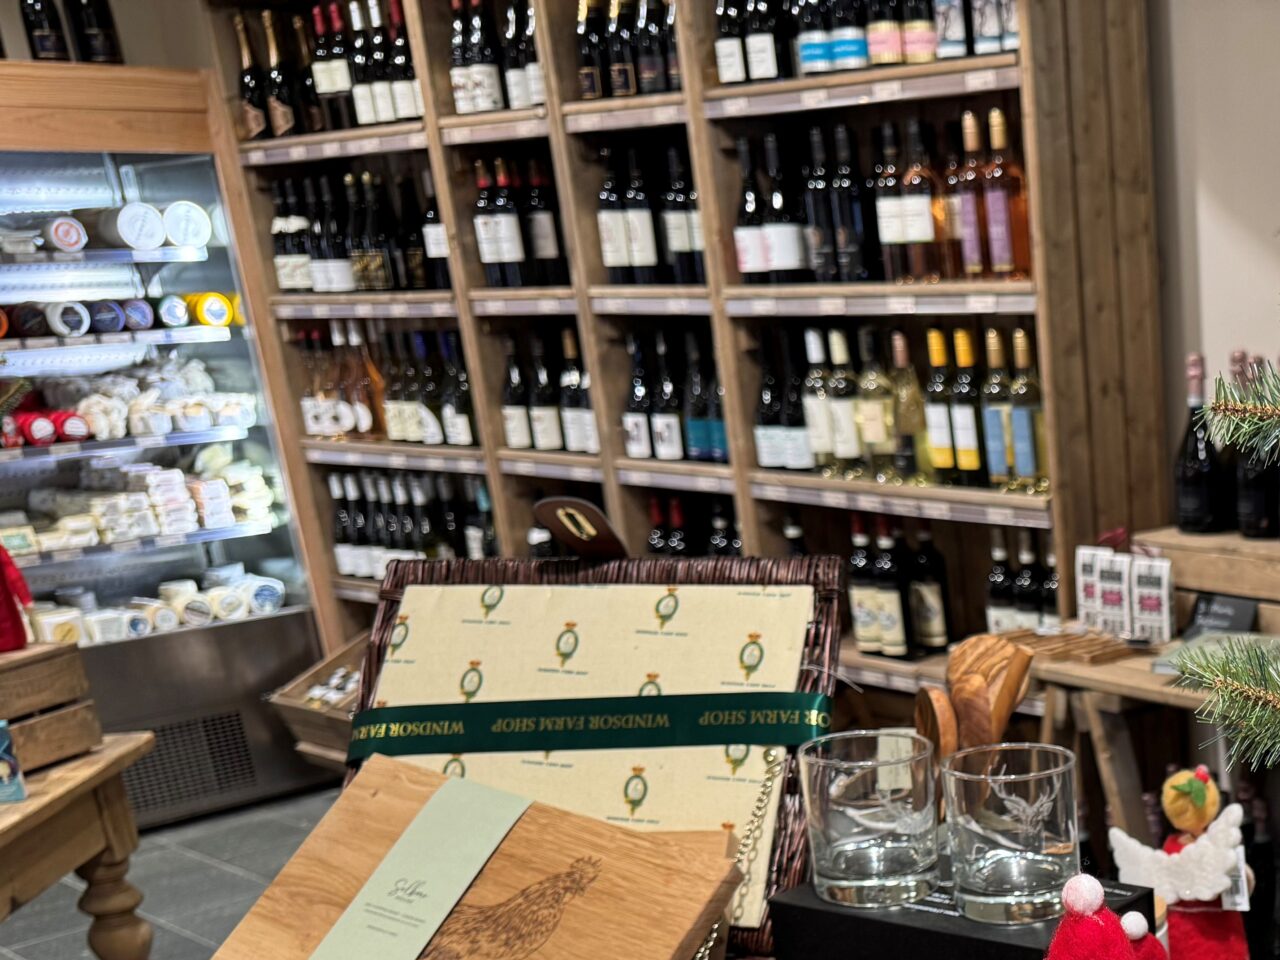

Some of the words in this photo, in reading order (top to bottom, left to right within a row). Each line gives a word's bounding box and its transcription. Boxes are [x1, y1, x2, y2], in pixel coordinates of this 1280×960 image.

[490, 717, 537, 734] SHOP
[539, 715, 585, 732] FARM
[589, 712, 671, 731] WINDSOR
[698, 710, 746, 727] SHOP
[750, 709, 801, 726] FARM
[389, 719, 465, 737] WINDSOR
